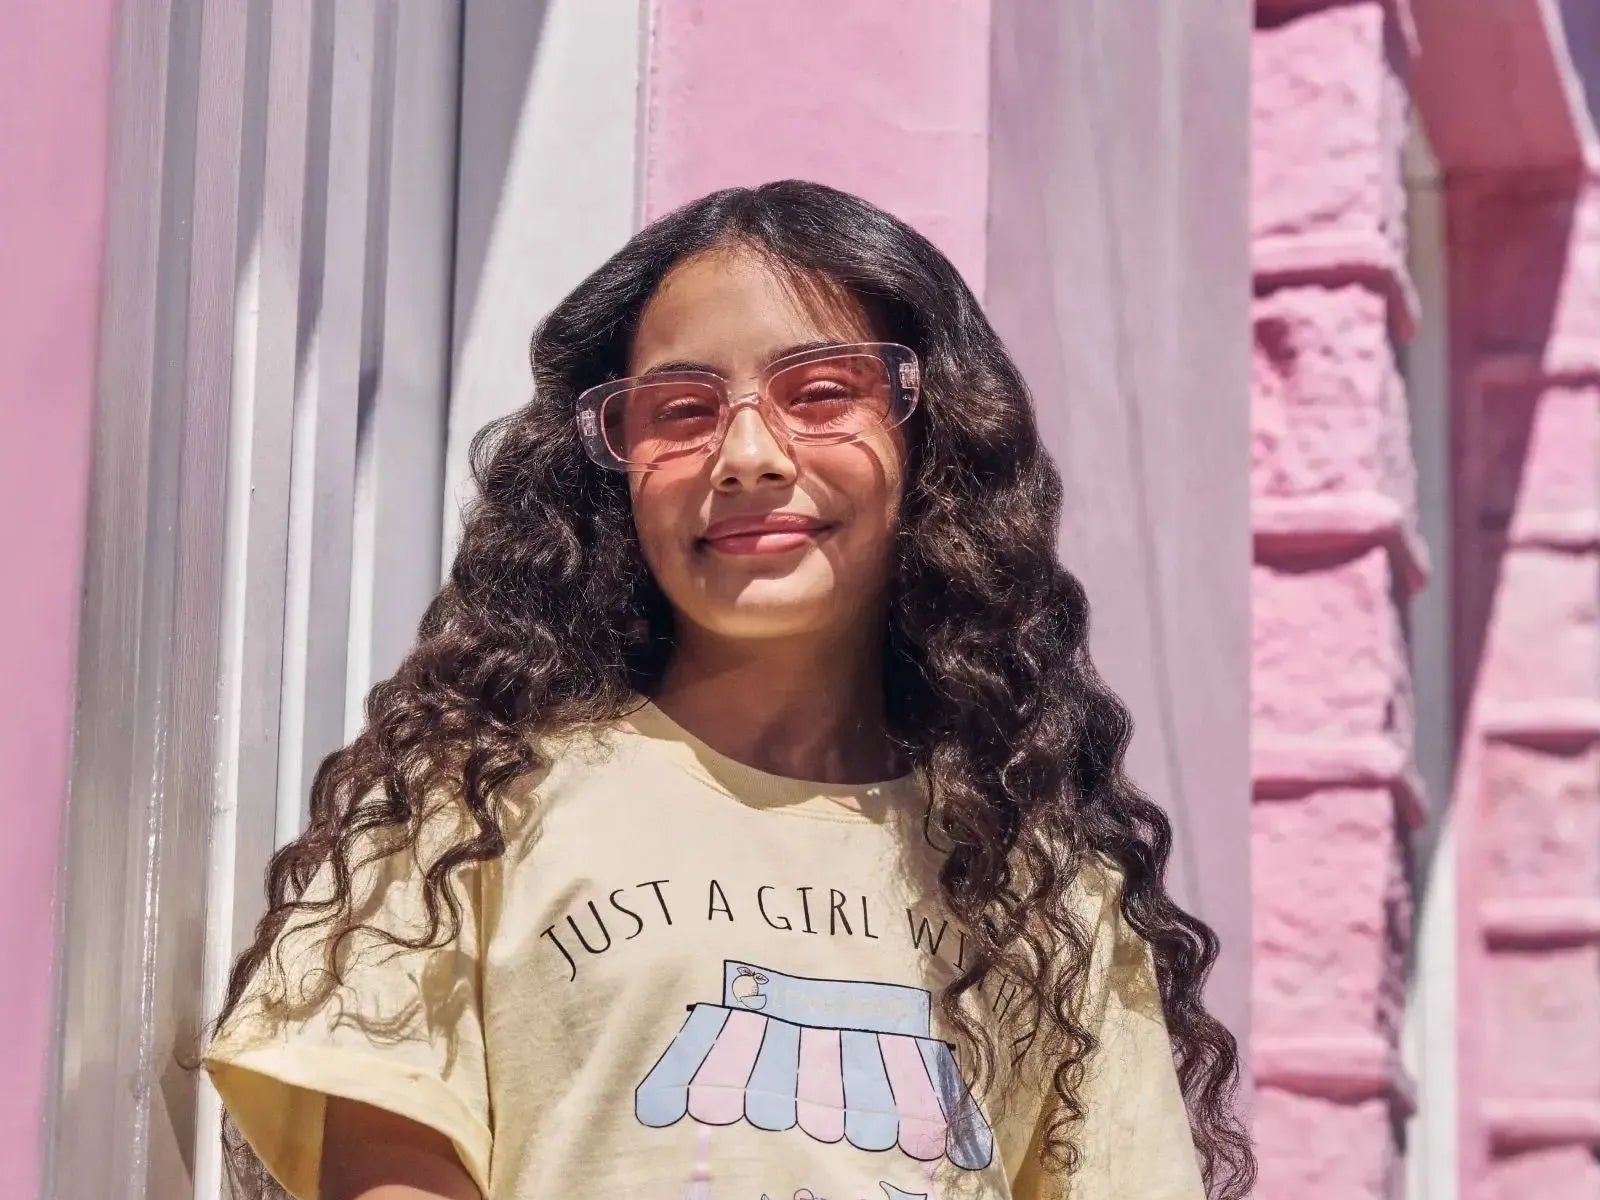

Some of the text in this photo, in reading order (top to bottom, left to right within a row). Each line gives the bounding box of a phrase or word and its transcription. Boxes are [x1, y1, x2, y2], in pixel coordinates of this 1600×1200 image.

[540, 879, 673, 982] JUST
[707, 879, 734, 922] A
[757, 886, 879, 939] GIRL
[906, 908, 1017, 1023] WIH
